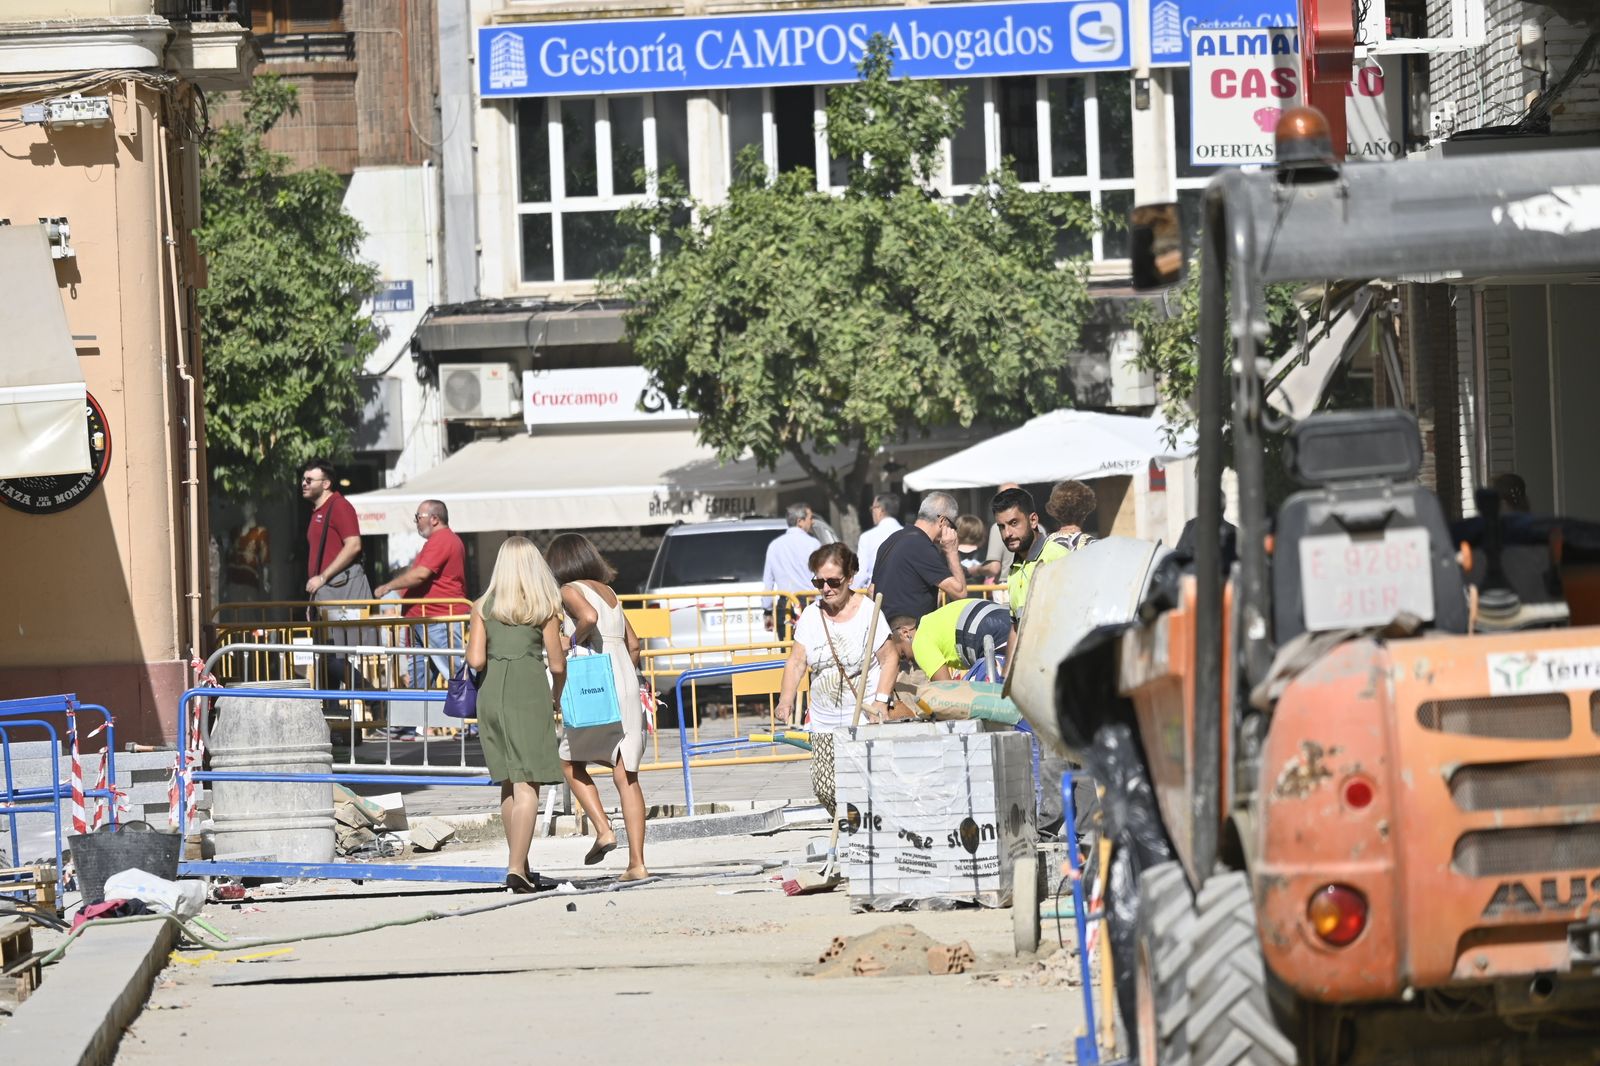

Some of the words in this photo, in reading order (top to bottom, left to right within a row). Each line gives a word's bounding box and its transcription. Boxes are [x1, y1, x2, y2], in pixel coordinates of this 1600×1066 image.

[696, 23, 870, 72] CAMPOS
[886, 16, 1053, 70] Abogados
[1197, 34, 1299, 56] ALMA
[1196, 143, 1274, 157] OFERTAS
[532, 391, 619, 407] Cruzcampo
[580, 686, 605, 695] Aromas
[1481, 876, 1600, 917] AU
